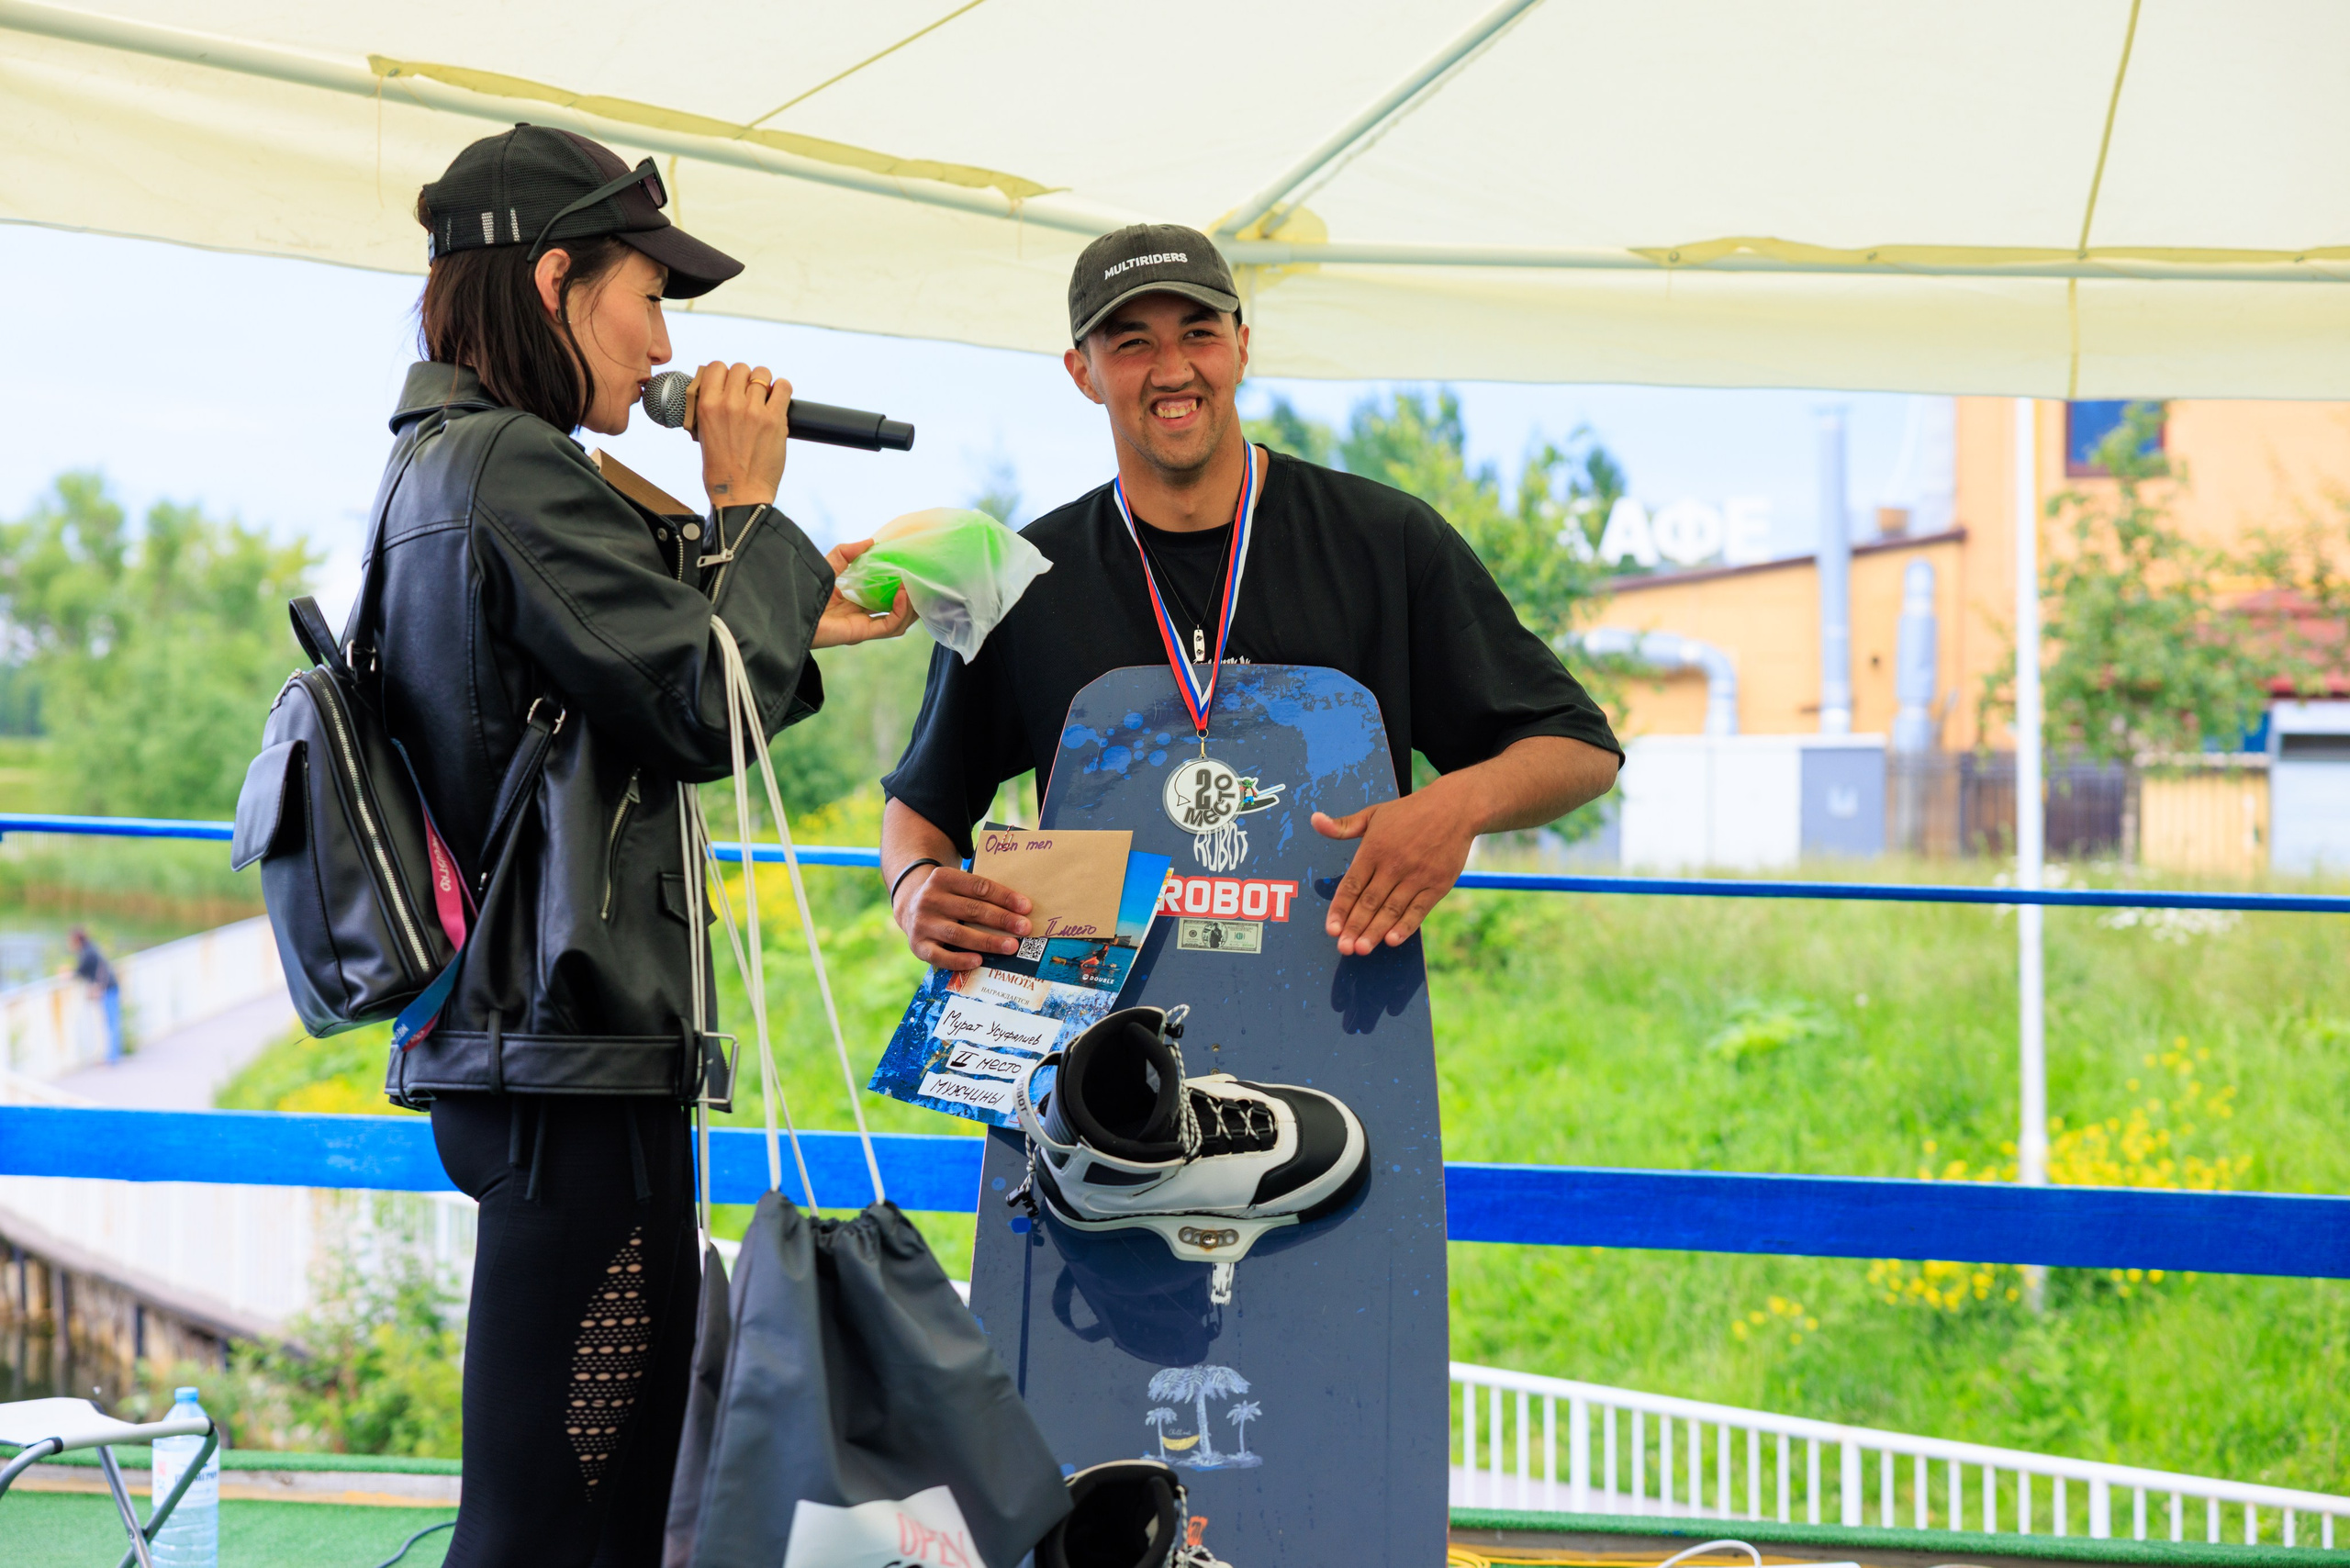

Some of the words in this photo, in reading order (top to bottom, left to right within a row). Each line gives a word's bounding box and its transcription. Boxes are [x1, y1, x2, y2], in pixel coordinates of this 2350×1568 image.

[1104, 252, 1188, 280] MULTIRIDERS
[1195, 768, 1211, 810] 2
[1025, 840, 1053, 850] men
[1158, 879, 1294, 917] ROBOT
[988, 969, 1035, 991] ГРАМОТА
[1090, 975, 1114, 985] DOUBLE
[980, 987, 1030, 1005] НАГРАЖДАЕТСЯ
[943, 1010, 983, 1036] Мурат
[930, 1079, 1005, 1105] МУЖЧИНЫ
